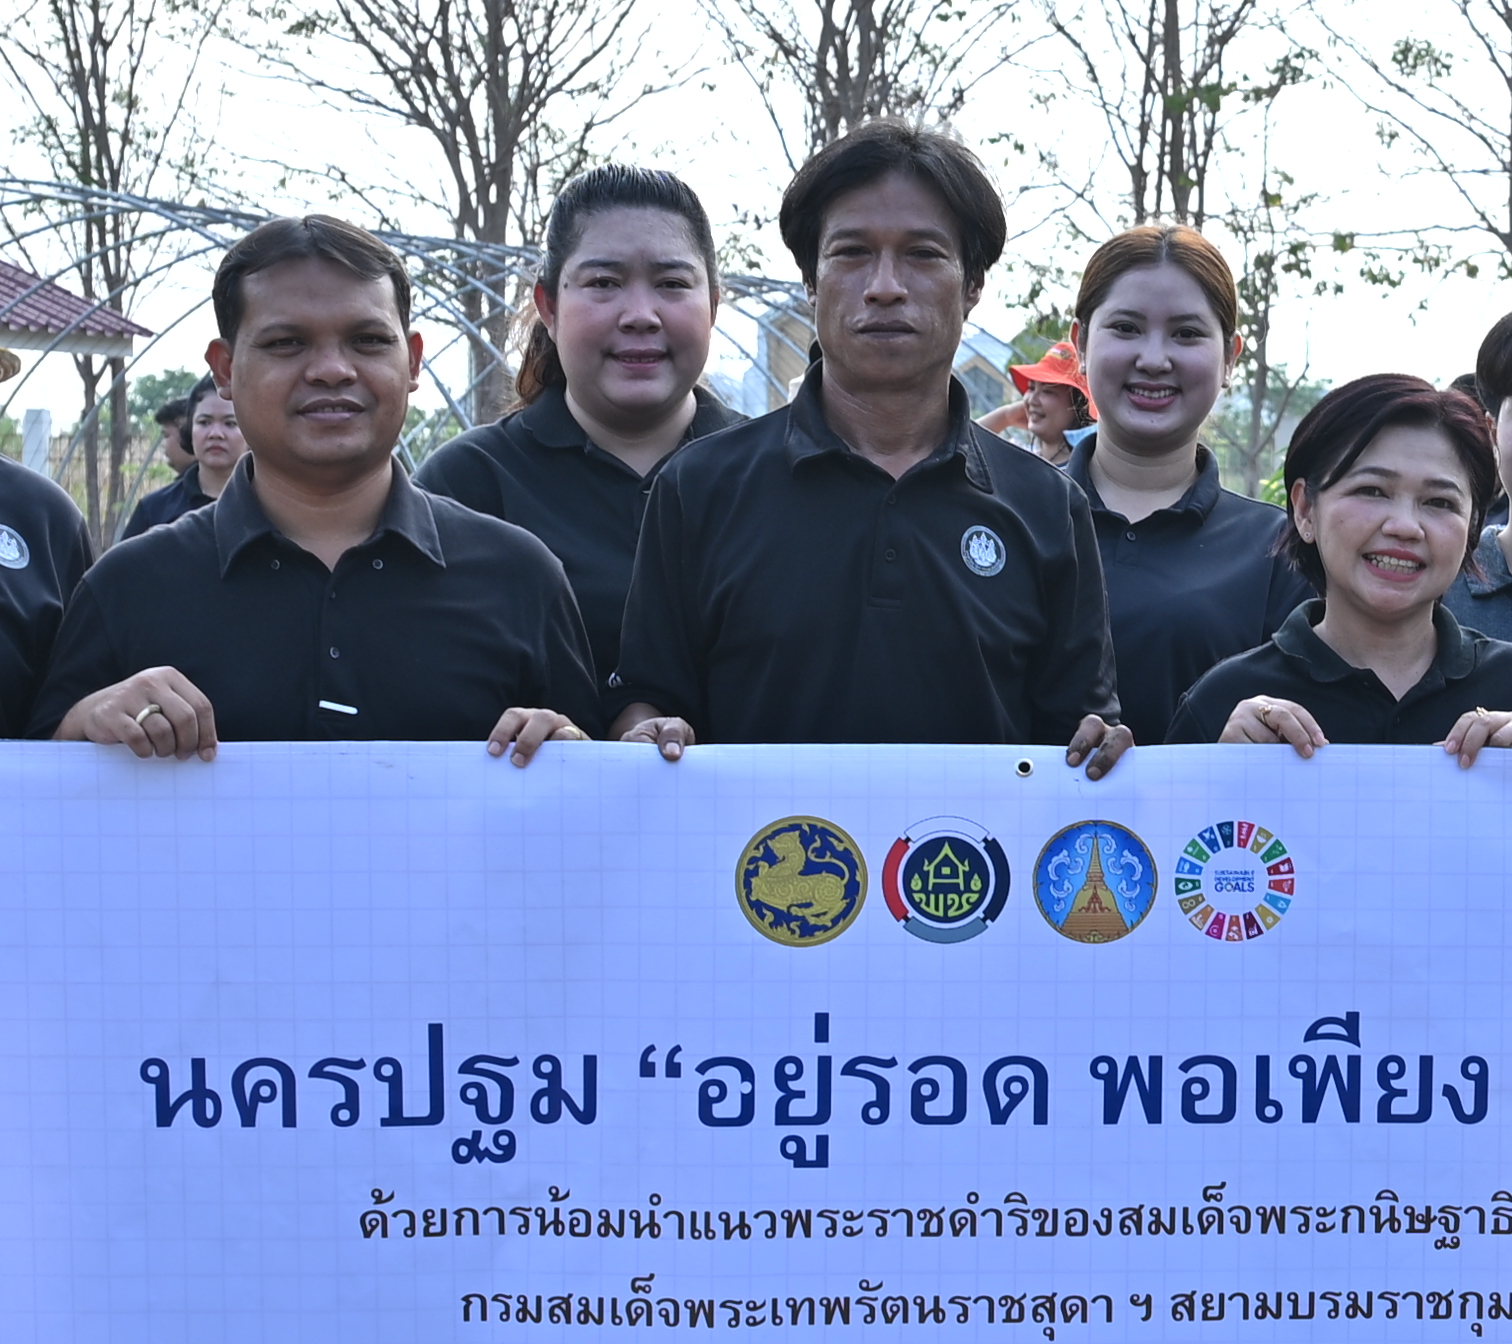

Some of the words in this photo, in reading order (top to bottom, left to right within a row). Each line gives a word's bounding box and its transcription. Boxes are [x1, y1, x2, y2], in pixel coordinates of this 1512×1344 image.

[1214, 882, 1255, 893] GOALS
[139, 1022, 598, 1165] นครปฐม
[639, 1012, 1049, 1169] “อยู่รอด
[1089, 1011, 1489, 1125] พอเพียง
[460, 1272, 1114, 1342] กรมสมเด็จพระเทพรัตนราชสุดา
[1129, 1293, 1153, 1322] ฯ
